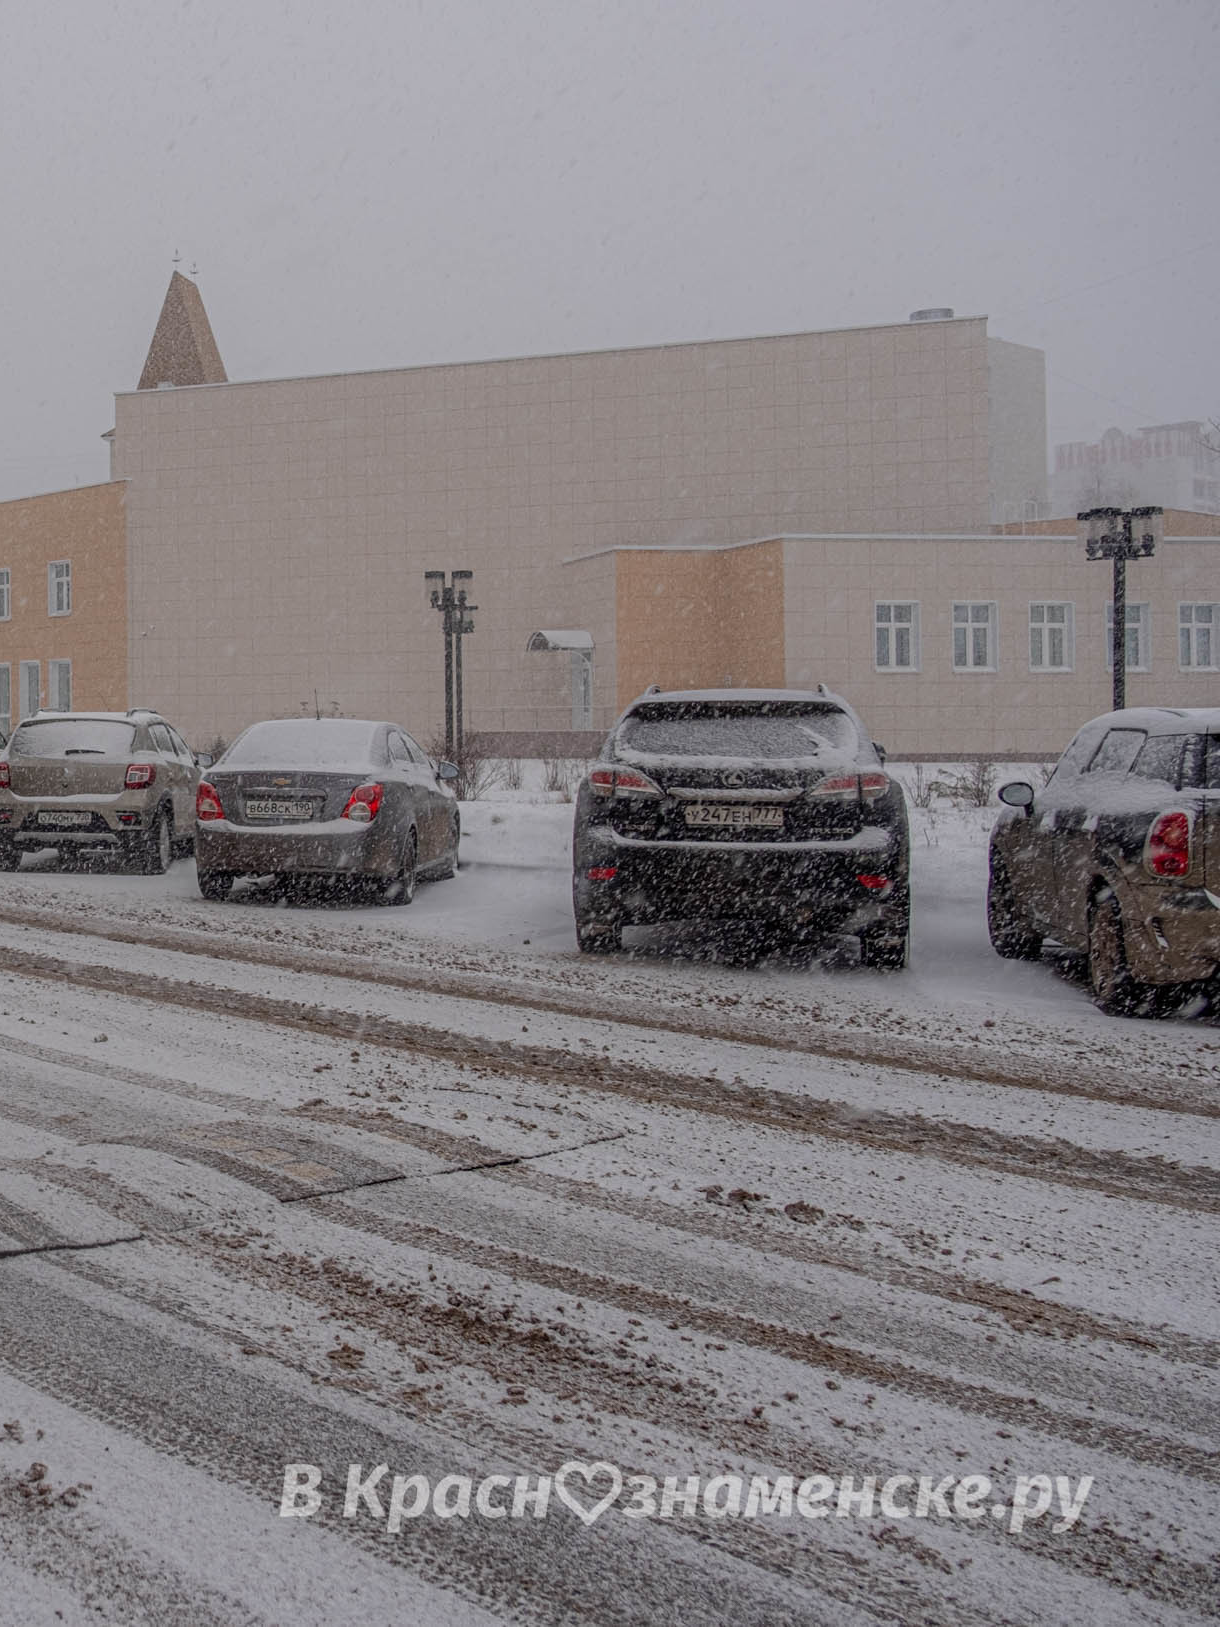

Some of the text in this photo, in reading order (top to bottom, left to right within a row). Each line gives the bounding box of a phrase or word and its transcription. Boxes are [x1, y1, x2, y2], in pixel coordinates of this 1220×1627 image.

[250, 802, 310, 813] В668СК 190
[691, 807, 778, 822] У247ЕН 777
